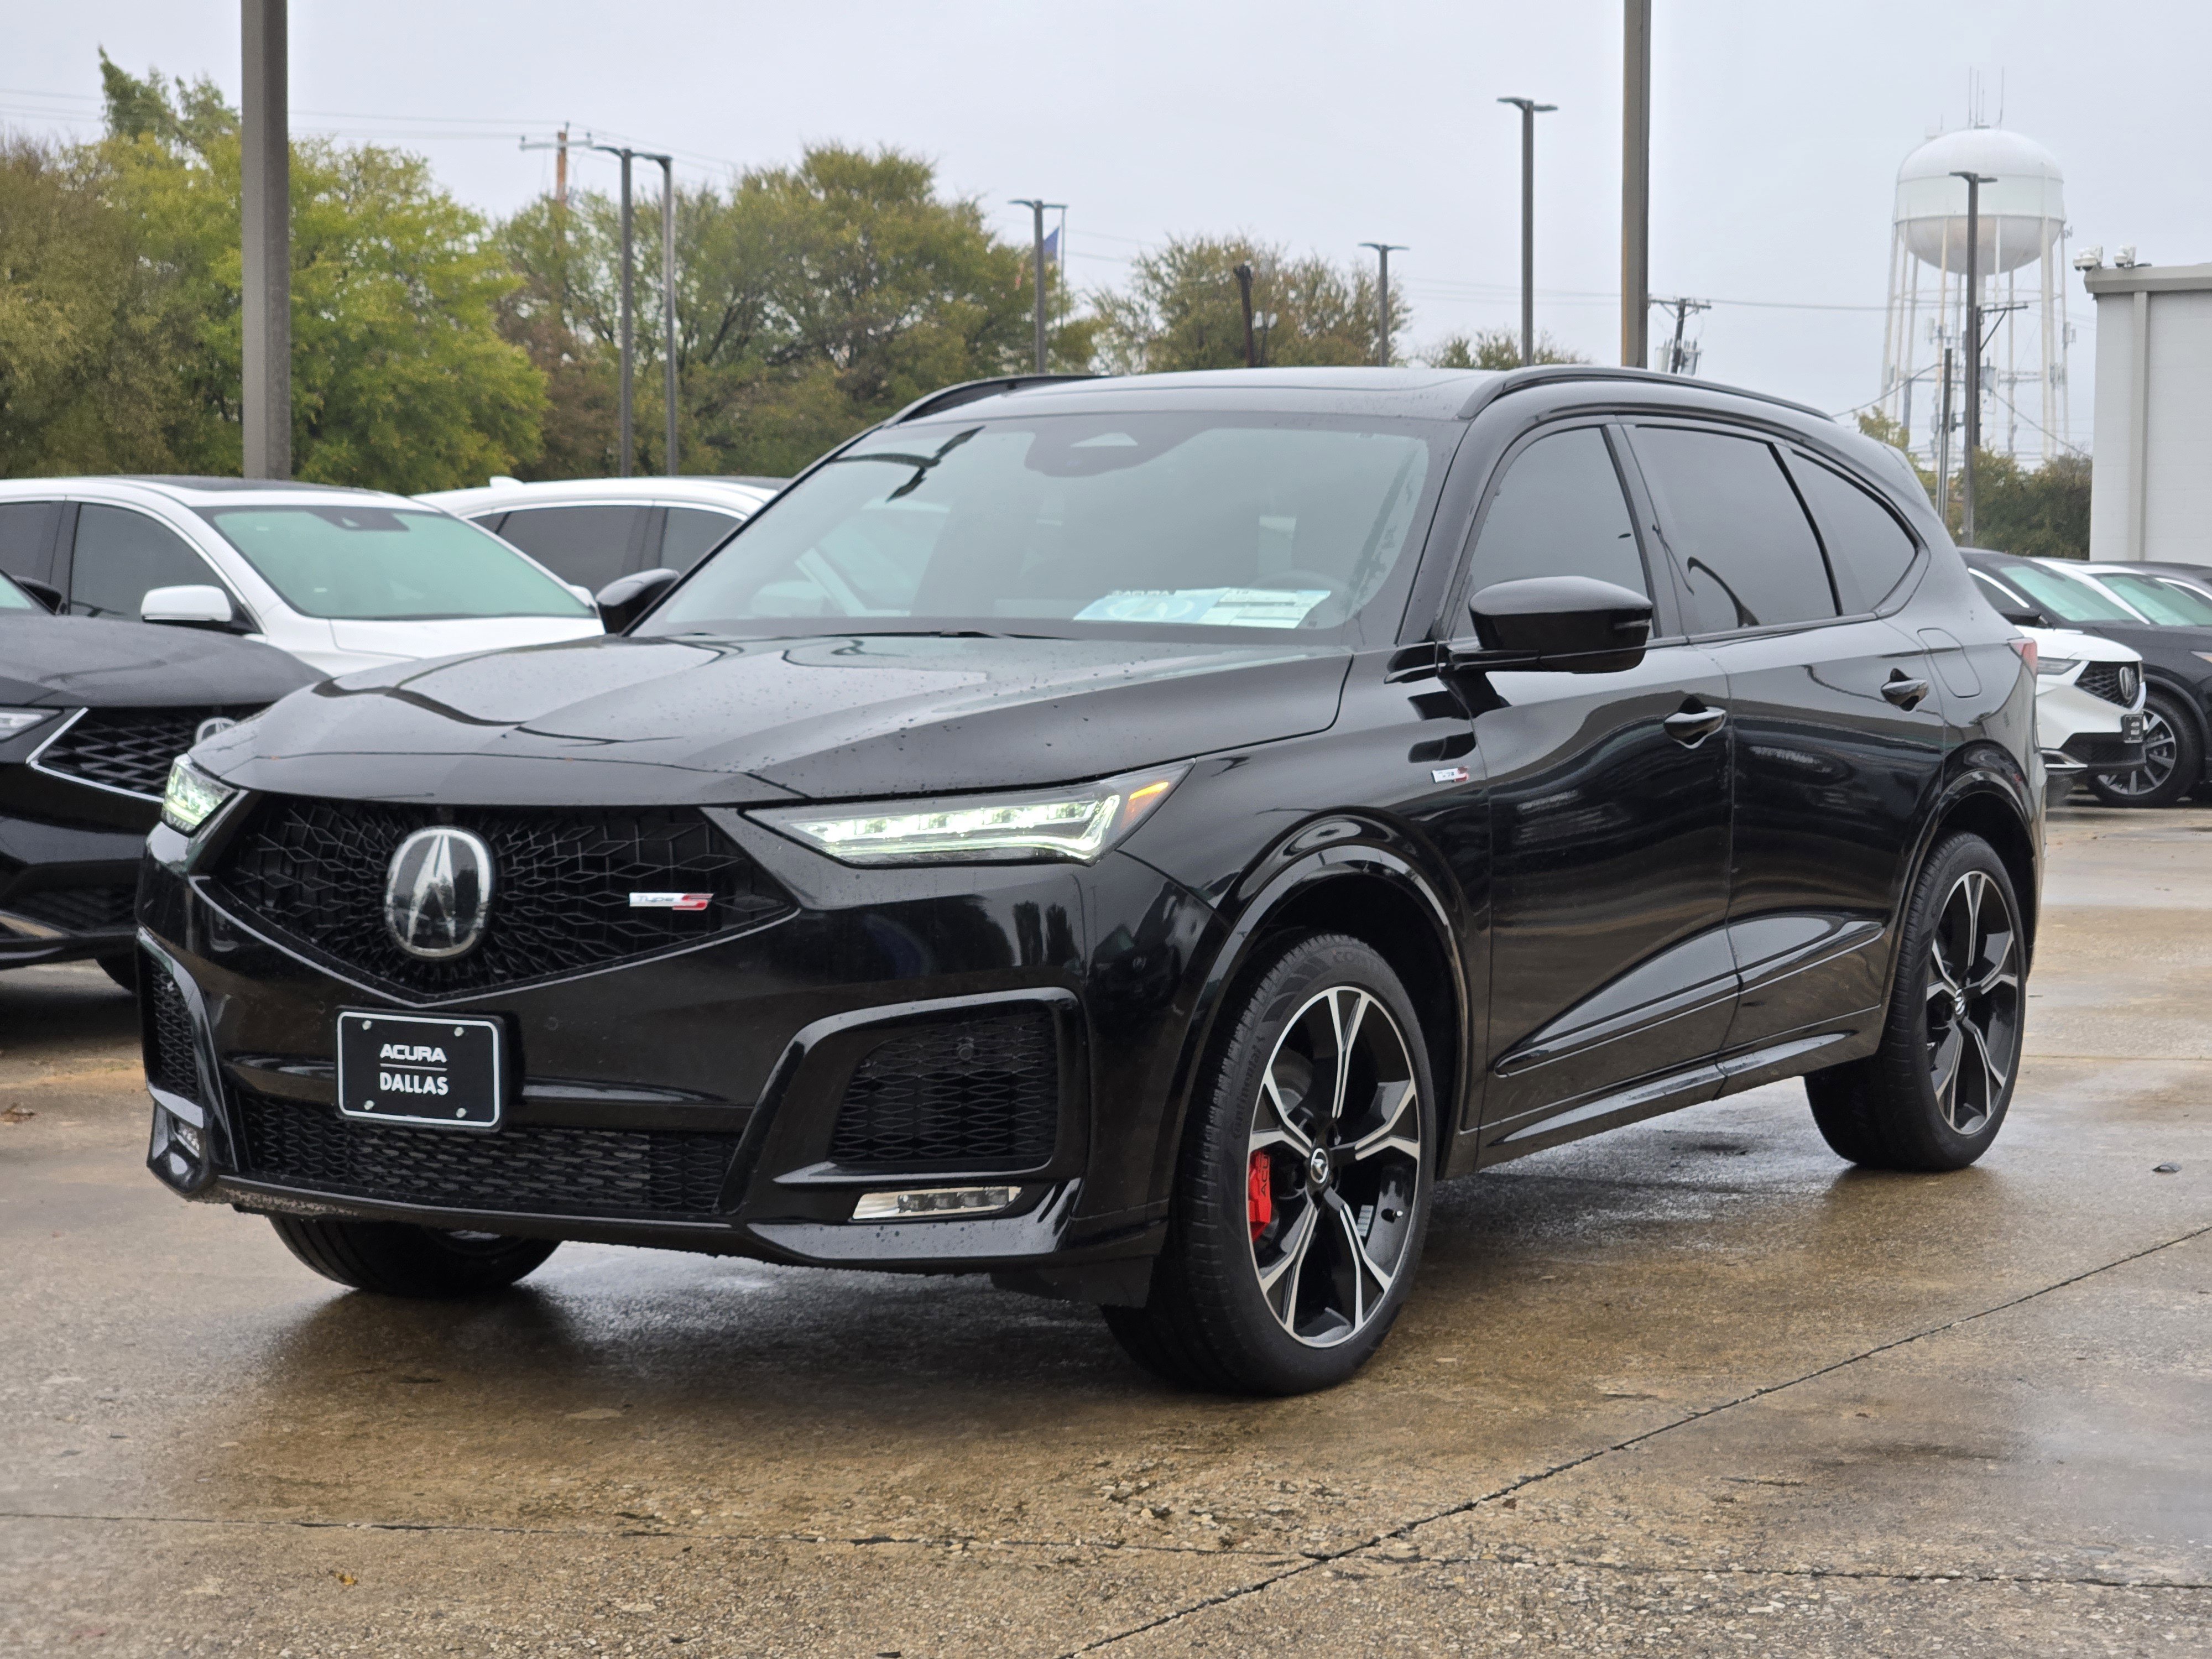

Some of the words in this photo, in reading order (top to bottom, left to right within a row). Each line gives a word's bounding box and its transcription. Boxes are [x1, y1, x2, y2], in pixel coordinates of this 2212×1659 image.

[672, 893, 714, 911] S
[380, 1044, 447, 1063] ACURA
[380, 1072, 448, 1095] DALLAS
